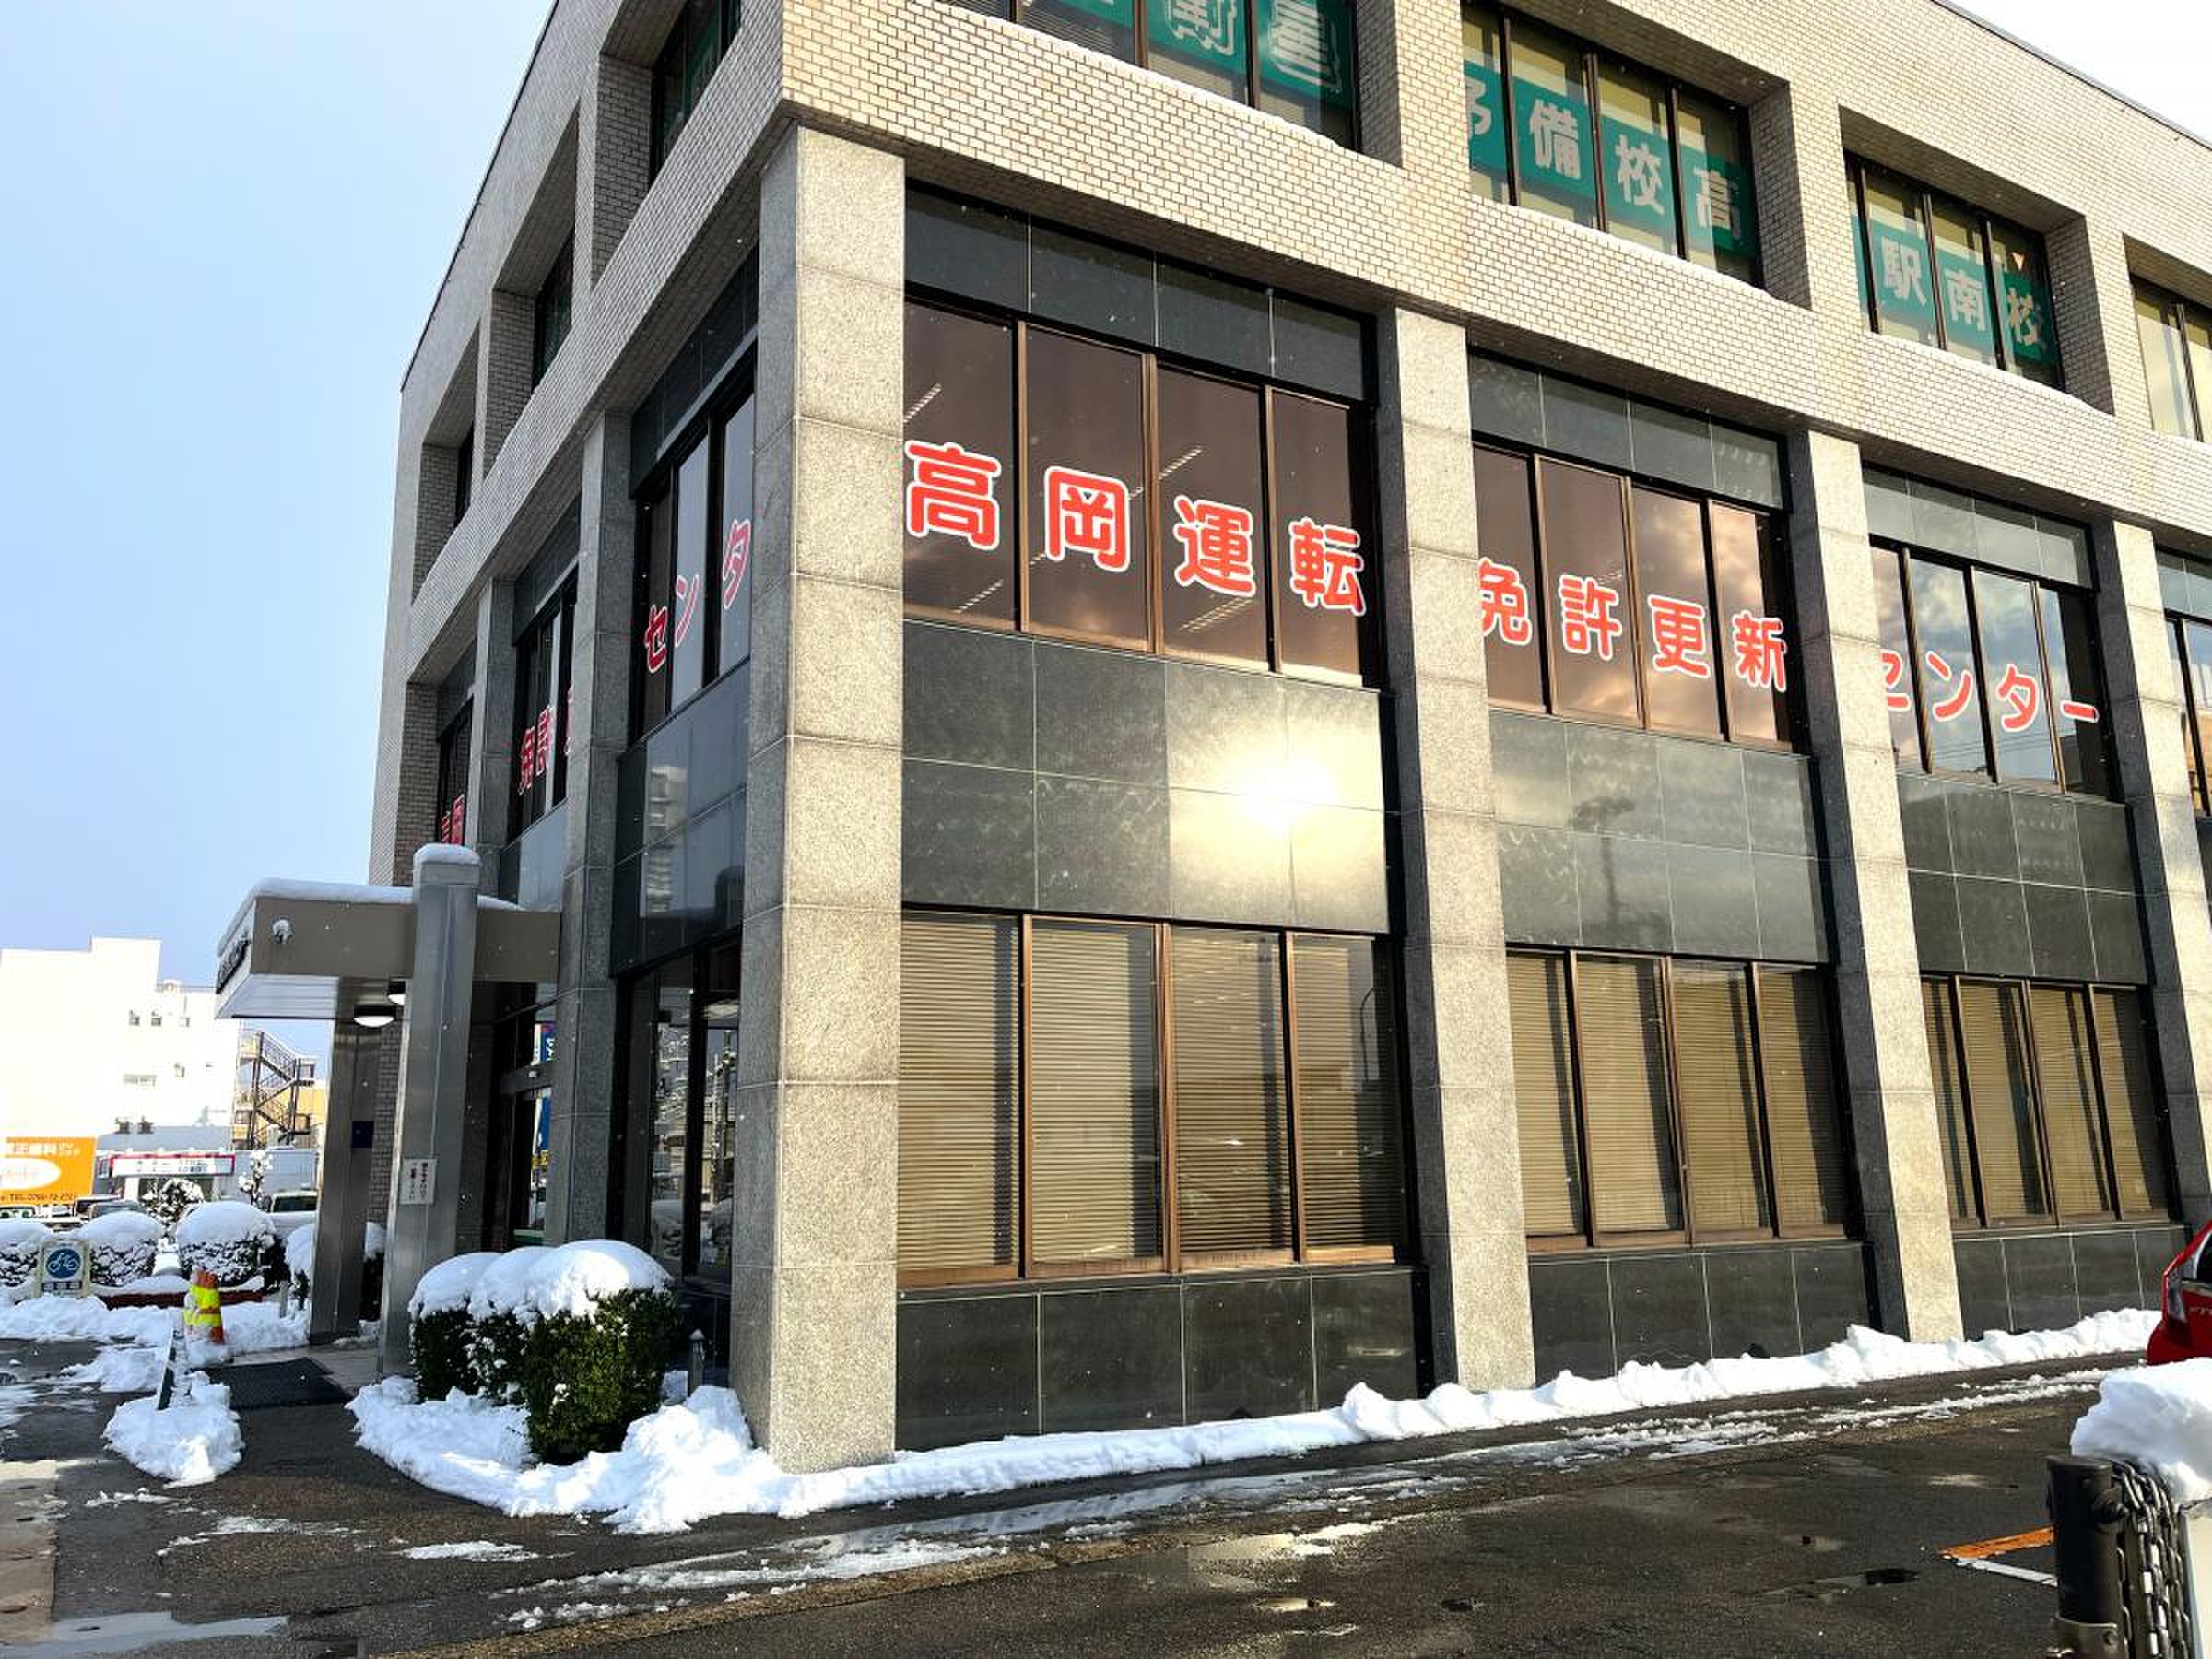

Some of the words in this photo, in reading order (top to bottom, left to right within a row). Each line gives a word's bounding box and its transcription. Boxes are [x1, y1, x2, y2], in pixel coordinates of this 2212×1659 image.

[1881, 235, 2048, 353] 駅南校
[906, 441, 1367, 616] 高岡運転
[1477, 557, 1786, 692] 免許更新
